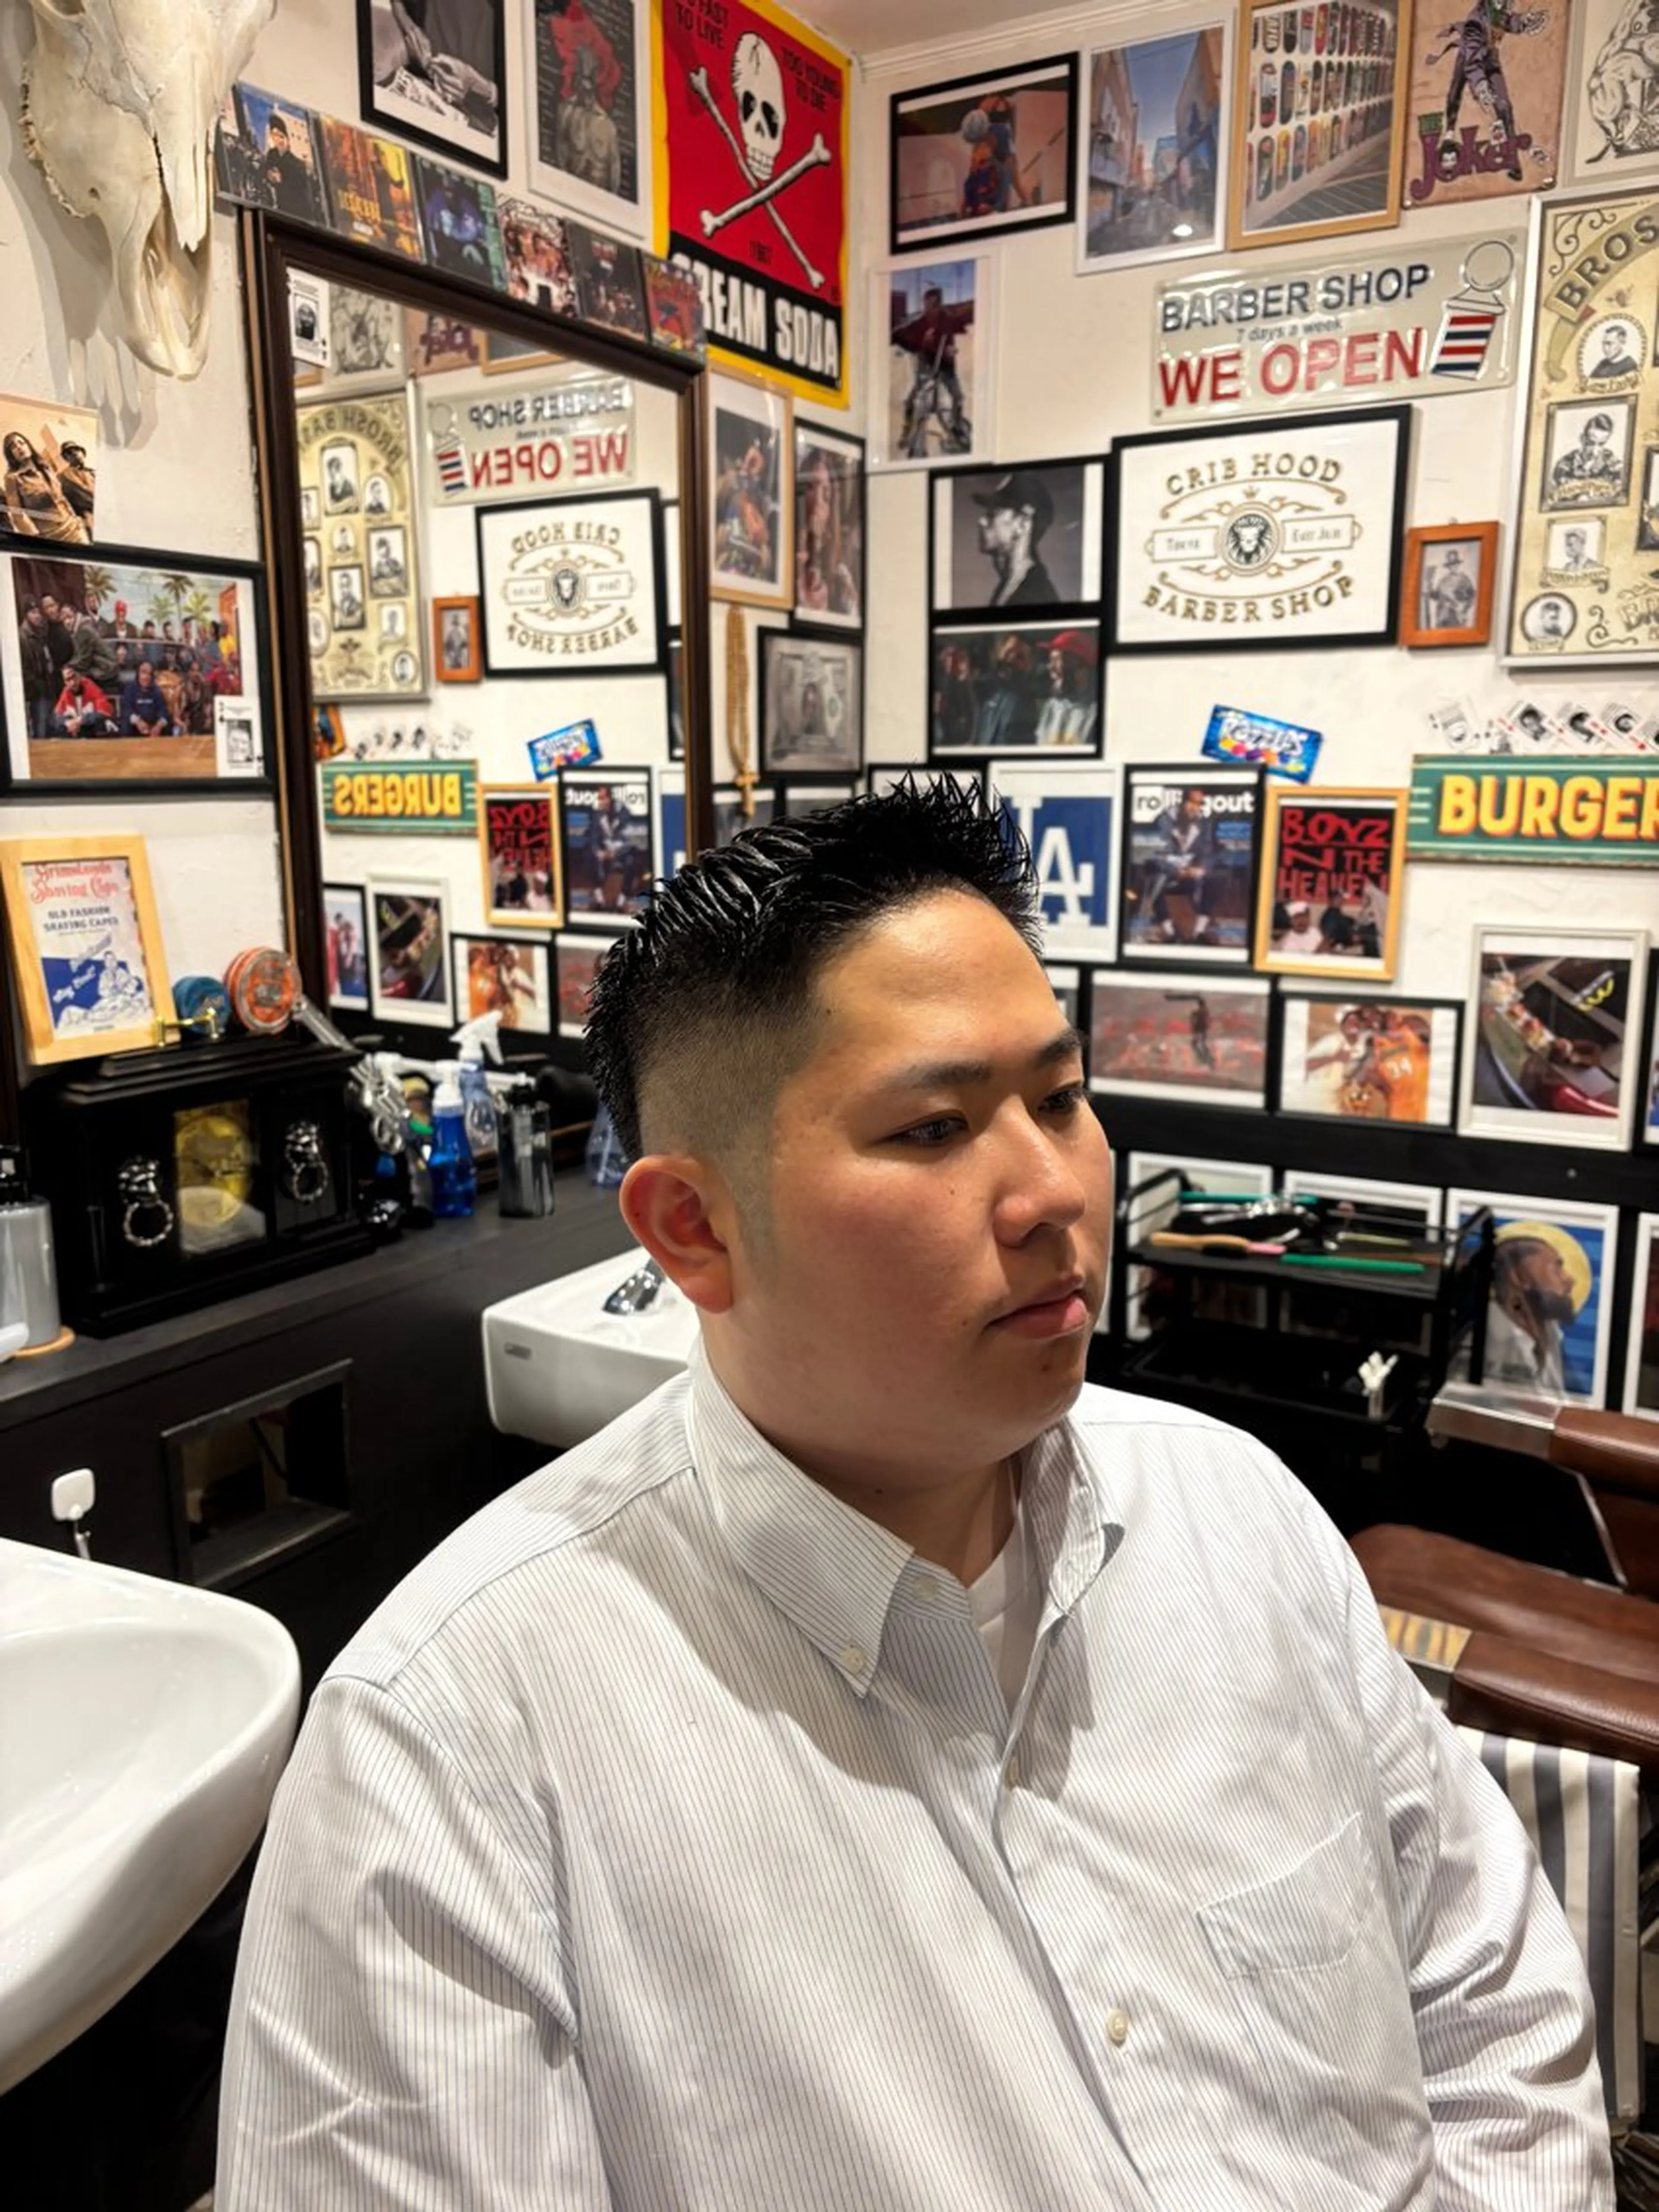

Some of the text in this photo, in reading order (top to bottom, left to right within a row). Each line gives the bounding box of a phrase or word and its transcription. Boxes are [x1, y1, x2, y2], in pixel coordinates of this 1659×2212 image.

[672, 252, 840, 378] REAM SODA
[1162, 264, 1430, 333] BARBER SHOP
[1236, 328, 1246, 343] 7
[1248, 326, 1284, 343] days
[1303, 318, 1343, 336] week
[1159, 327, 1424, 407] WE OPEN
[1166, 453, 1342, 496] CRIB HOOD
[1141, 575, 1354, 623] BARBER SHOP
[1282, 808, 1390, 848] BOYZ
[1282, 847, 1385, 874] N THE
